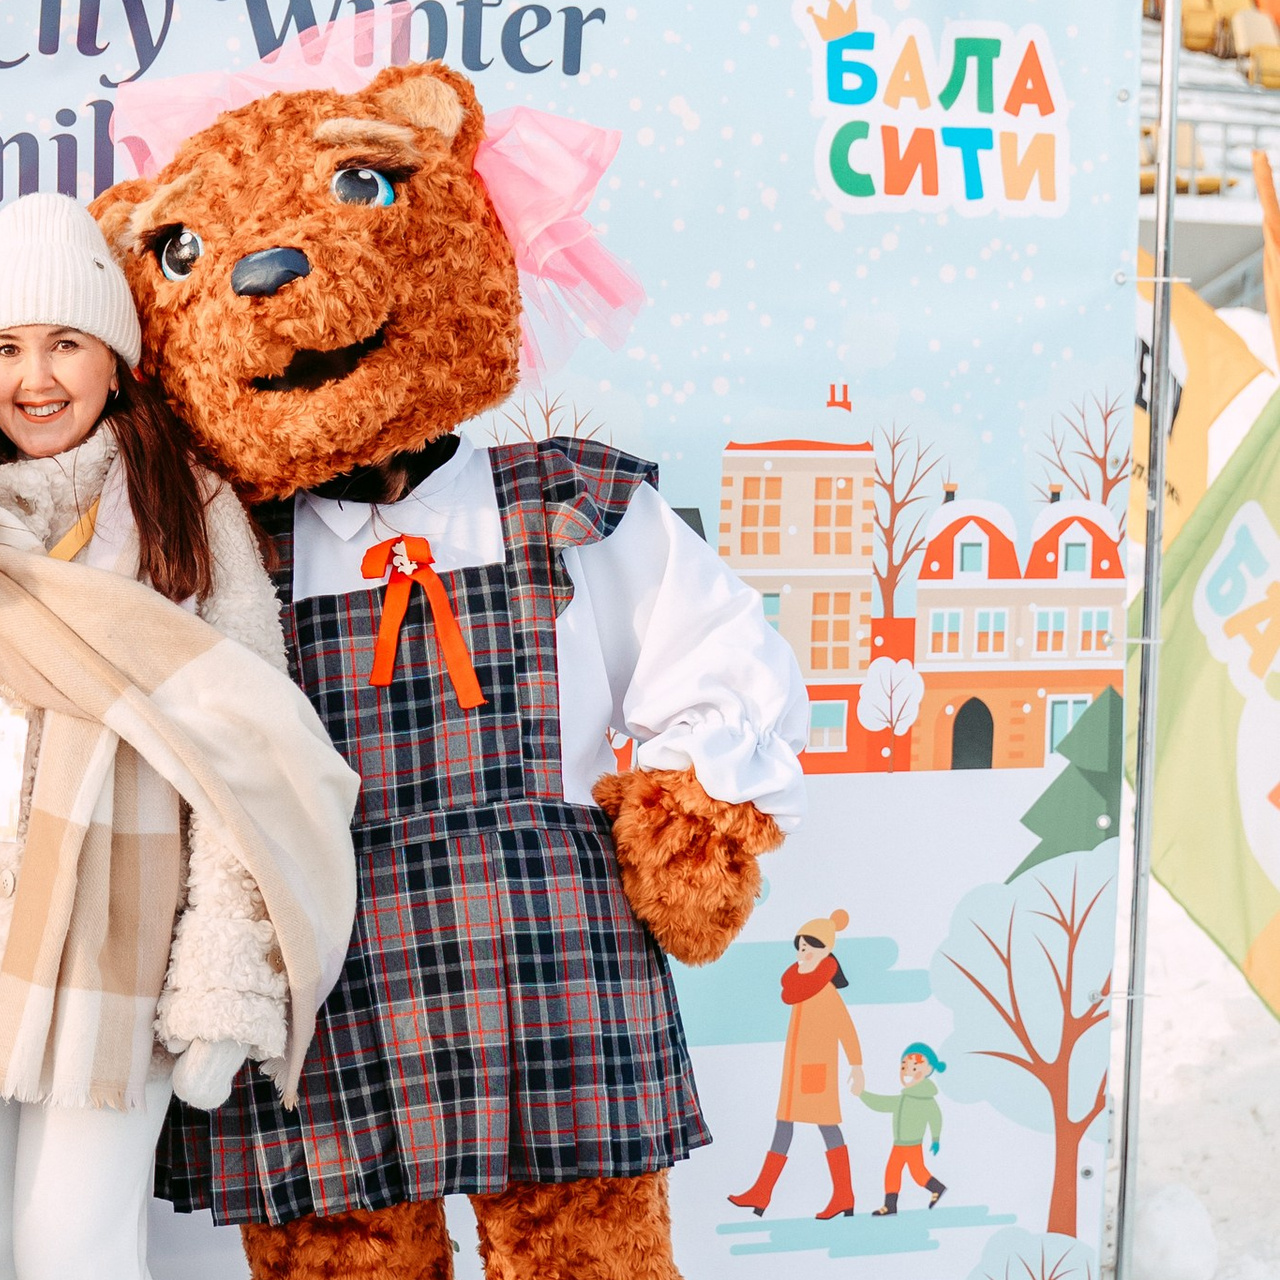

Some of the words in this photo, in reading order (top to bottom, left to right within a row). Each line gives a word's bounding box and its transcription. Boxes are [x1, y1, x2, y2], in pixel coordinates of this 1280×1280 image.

[826, 31, 1055, 117] БАЛА
[829, 120, 1057, 202] СИТИ
[1205, 523, 1280, 701] БА
